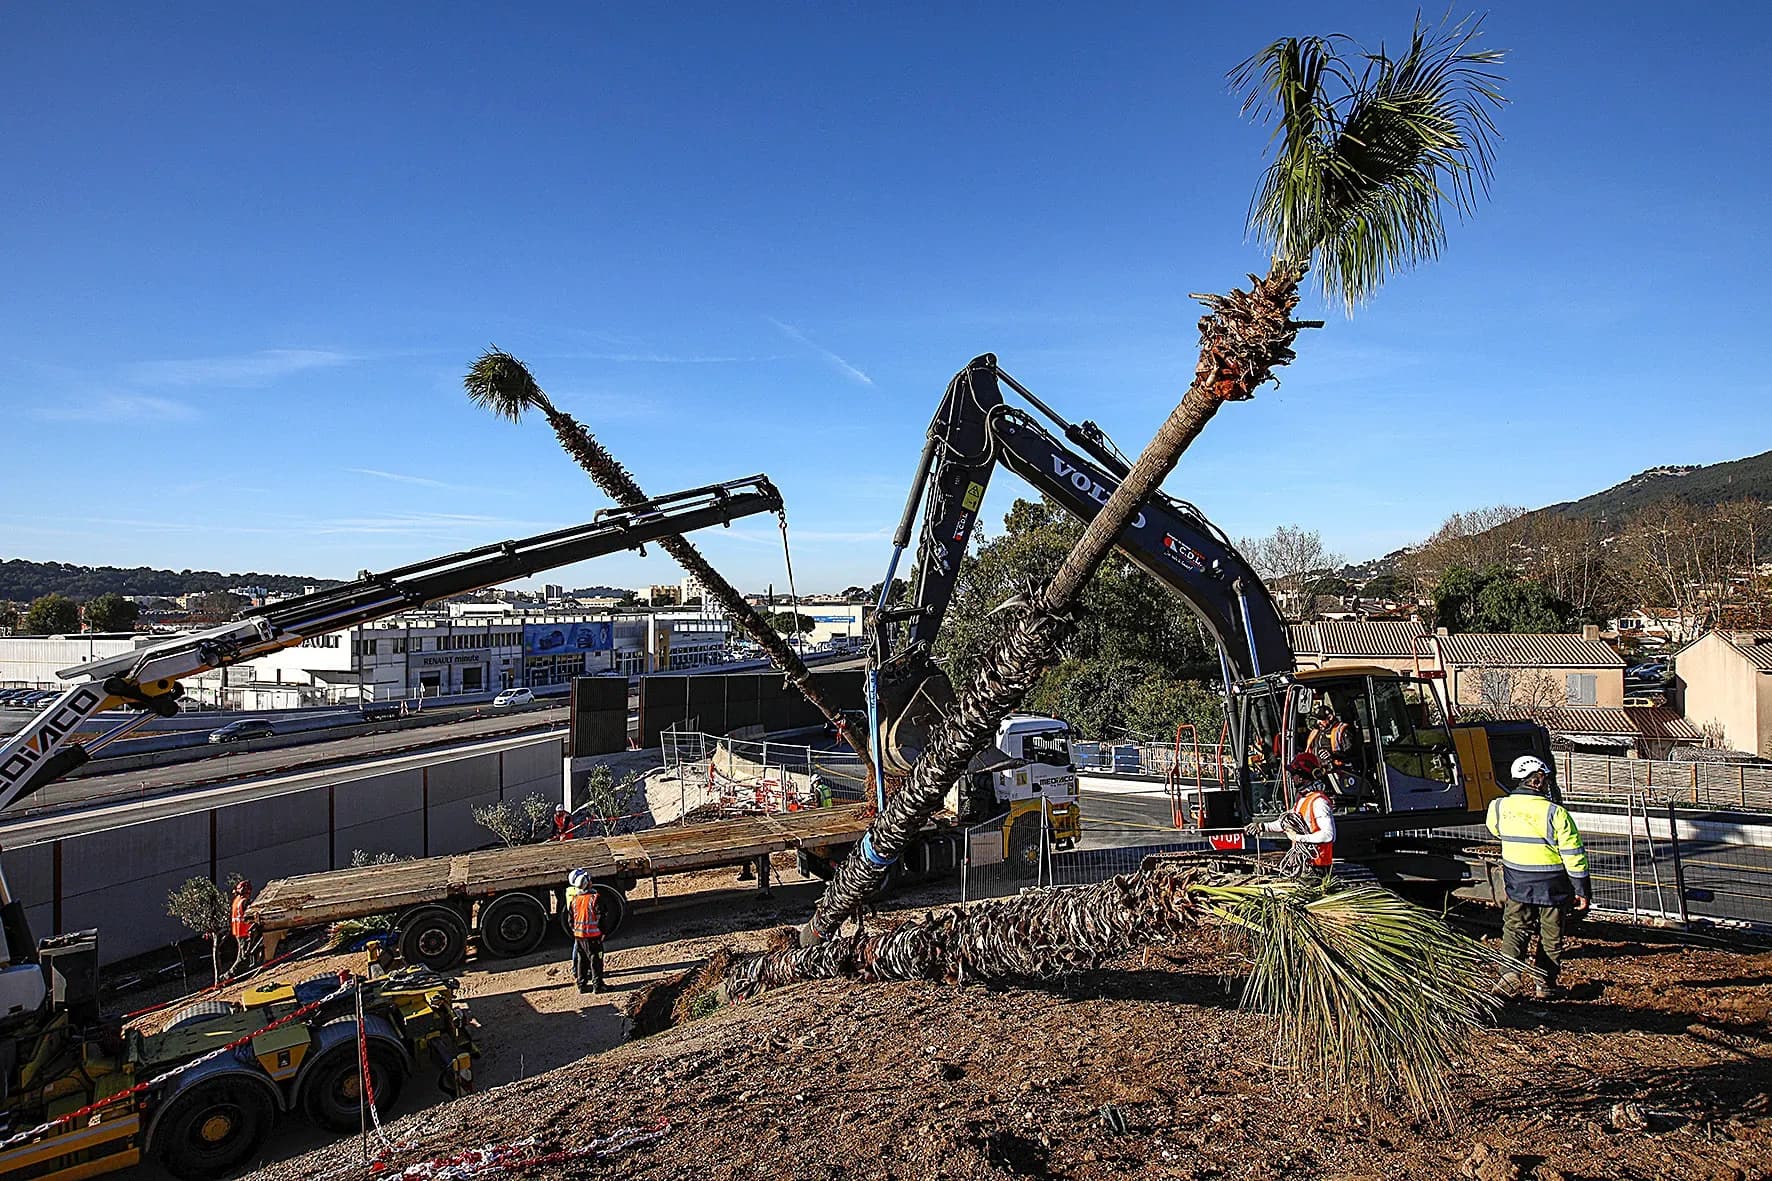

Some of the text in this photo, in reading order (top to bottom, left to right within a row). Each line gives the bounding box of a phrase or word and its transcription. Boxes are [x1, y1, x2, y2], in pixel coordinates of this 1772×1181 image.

[1051, 454, 1146, 529] VOLO
[301, 635, 342, 649] AULT
[423, 656, 453, 666] RENAULT
